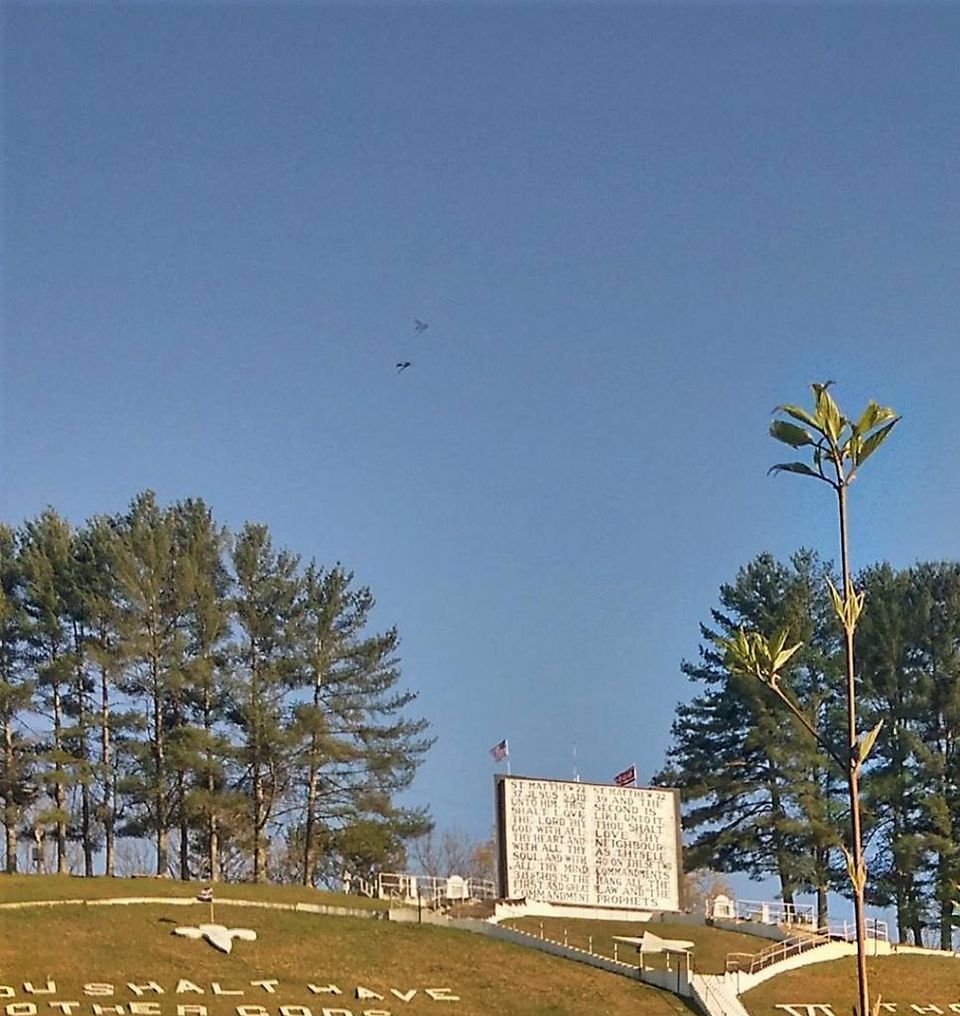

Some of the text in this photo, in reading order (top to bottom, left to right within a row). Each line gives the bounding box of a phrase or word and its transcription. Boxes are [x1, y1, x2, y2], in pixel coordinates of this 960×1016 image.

[511, 798, 538, 807] UNTO
[526, 790, 558, 800] JESUS
[563, 793, 586, 803] SAID
[612, 796, 634, 806] AND
[641, 798, 663, 809] THE
[511, 806, 585, 819] SHALT LOVE
[594, 803, 657, 817] SECOND IS
[538, 816, 566, 827] LORD
[594, 811, 664, 826] LIKE UNTO IT
[511, 824, 533, 834] GOD
[536, 826, 562, 836] WITH
[596, 820, 664, 835] THOU SHALT
[513, 833, 587, 847] THY HEART AND
[595, 829, 661, 844] LOVE THY
[512, 842, 538, 852] WITH
[567, 845, 587, 856] THY
[595, 838, 666, 852] NEIGHBOUR
[595, 847, 611, 857] AS
[544, 853, 563, 864] AND
[565, 855, 588, 866] WITH
[610, 857, 624, 867] ON
[627, 858, 656, 870] THESE
[657, 861, 673, 871] TWO
[514, 861, 589, 875] ALL THY MIND
[595, 867, 671, 881] COMMANDMENTS
[560, 873, 570, 883] IS
[572, 874, 589, 885] THE
[596, 876, 671, 890] HANG ALL THE
[513, 879, 590, 894] FIRST AND GREAT
[594, 885, 671, 900] LAW AND THE
[513, 888, 590, 902] COMMANDMENT
[596, 894, 659, 907] PROPHETS
[82, 979, 279, 998] SHALT
[307, 983, 461, 1002] HAVE
[5, 1001, 208, 1016] OTHER
